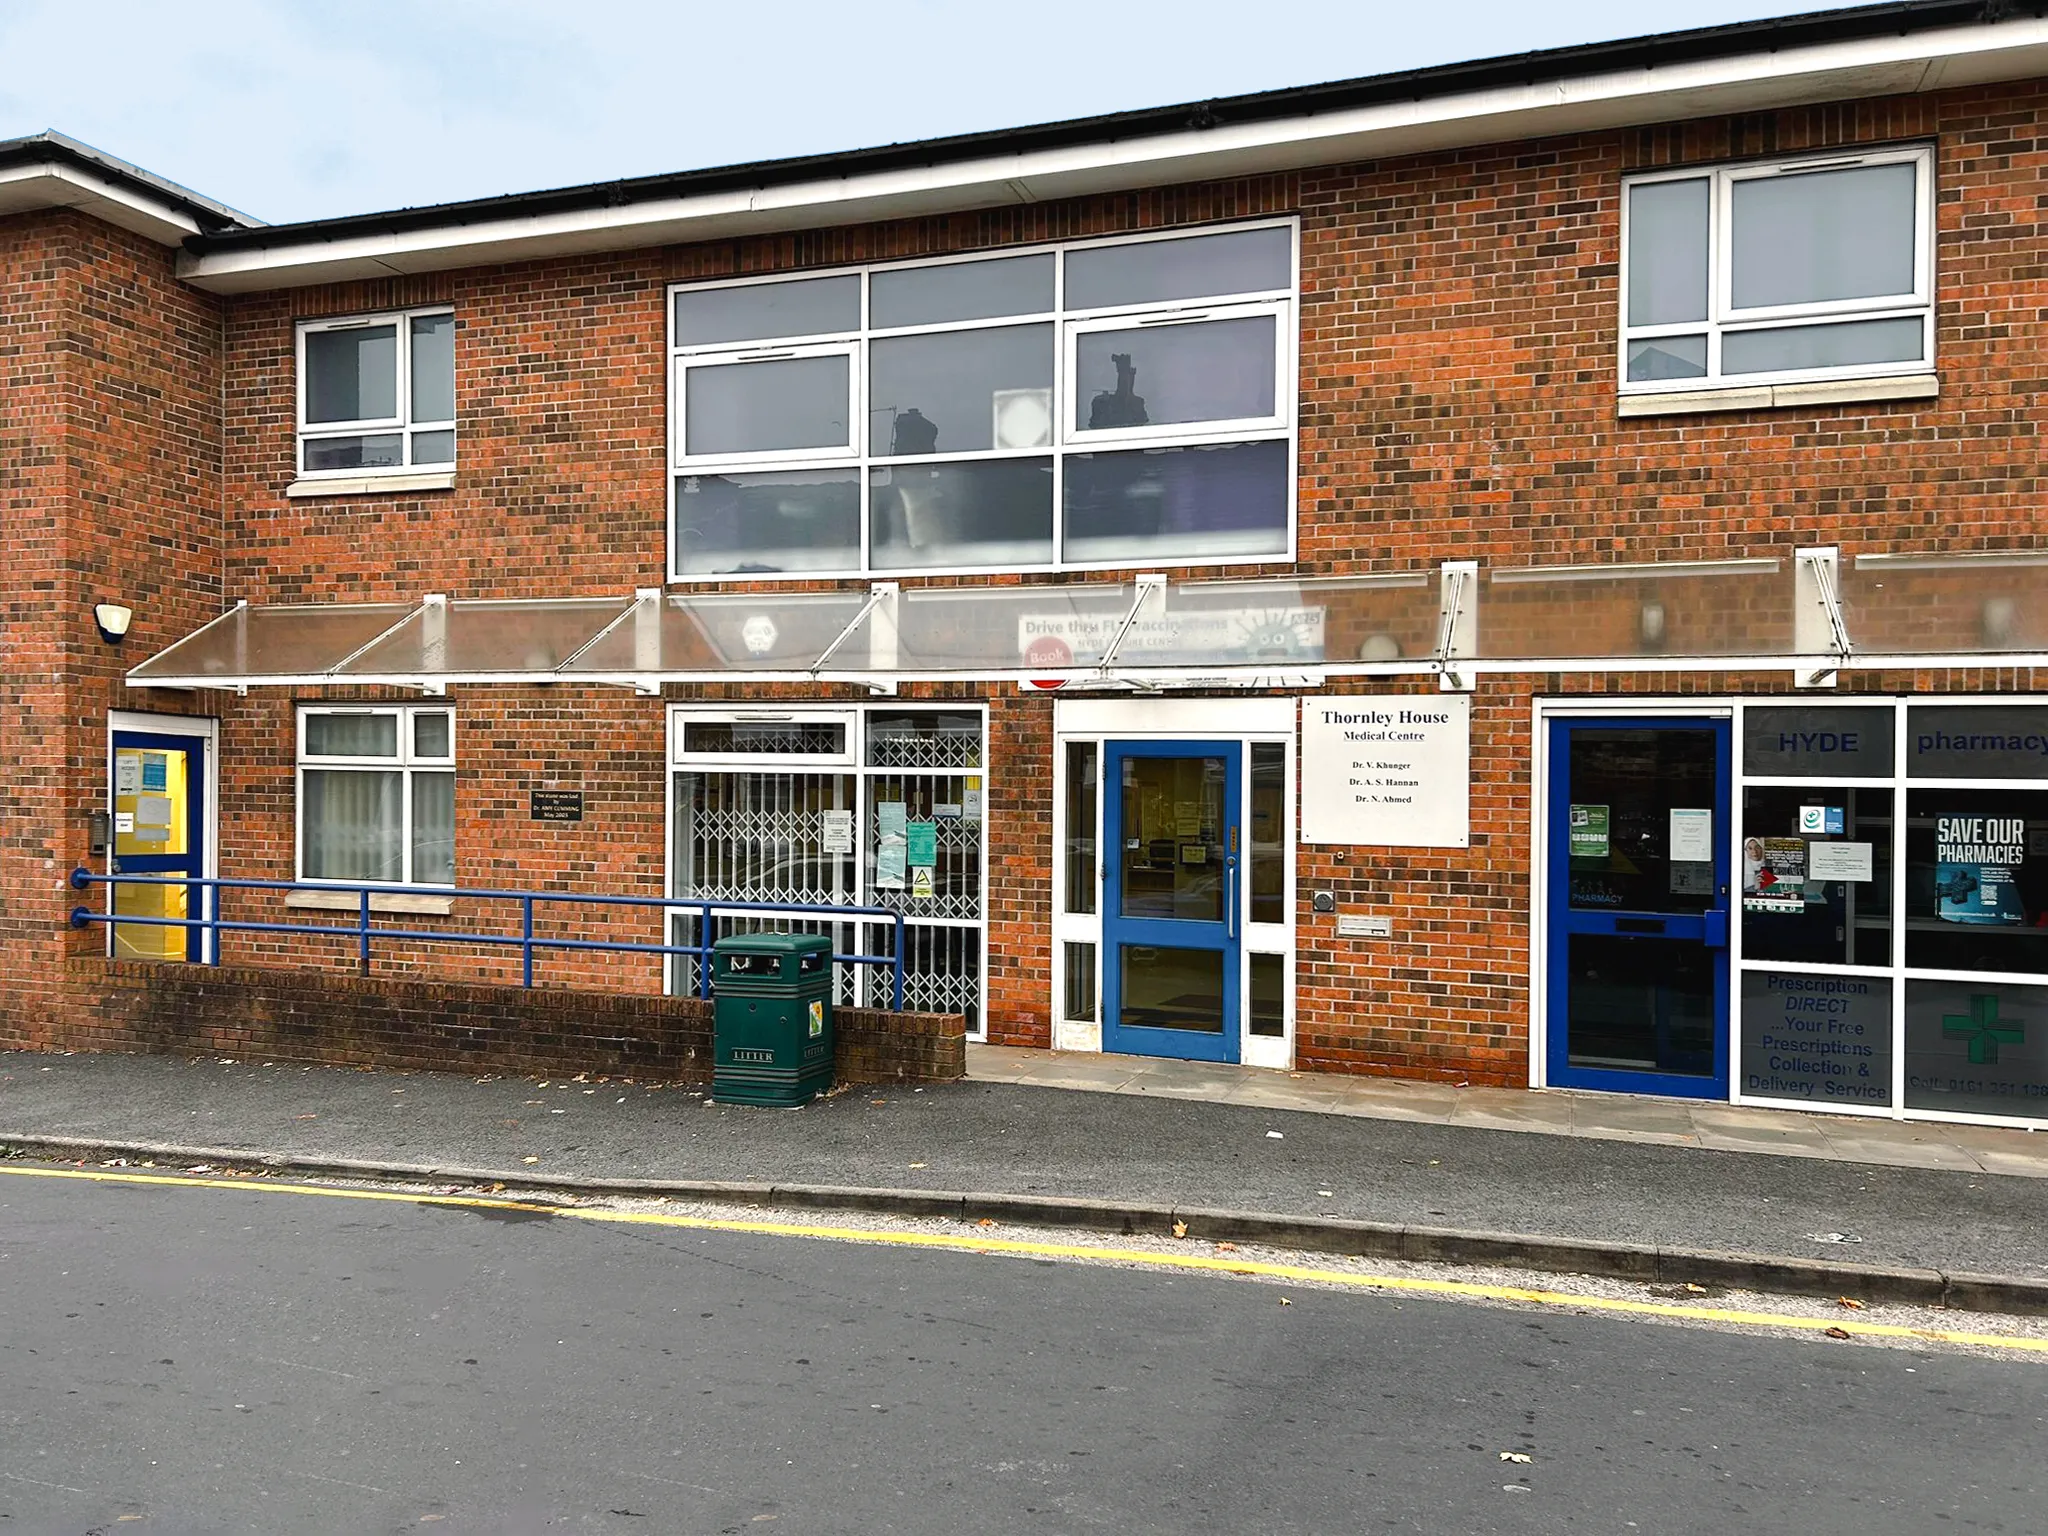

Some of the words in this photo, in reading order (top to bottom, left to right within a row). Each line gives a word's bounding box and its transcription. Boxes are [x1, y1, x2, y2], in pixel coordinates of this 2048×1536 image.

[1025, 620, 1064, 634] Drive
[1030, 648, 1065, 664] Book
[1321, 710, 1394, 727] Thornley
[1399, 710, 1450, 724] House
[1344, 731, 1385, 741] Medical
[1388, 731, 1425, 741] Centre
[1779, 732, 1859, 752] HYDE
[1918, 731, 2048, 755] pharmacy
[1352, 761, 1365, 769] Dr.
[1366, 761, 1375, 769] V.
[1349, 778, 1363, 786] Dr.
[1364, 778, 1374, 786] A.
[1375, 778, 1384, 786] S.
[1386, 778, 1419, 787] Hannan
[1355, 795, 1369, 803] Dr.
[1371, 795, 1381, 803] N.
[1382, 796, 1412, 804] Ahmed
[1938, 818, 1983, 843] SAVE
[1986, 819, 2025, 844] OUR
[1938, 845, 2024, 865] PHARMACIES
[1572, 894, 1624, 904] PHARMACY
[1768, 975, 1868, 996] Prescription
[1785, 996, 1851, 1014] DIRECT
[1828, 1019, 1865, 1036] Free
[1763, 1035, 1873, 1057] Prescriptions
[734, 1051, 773, 1061] LITTER
[1769, 1056, 1853, 1076] Collection
[1858, 1062, 1870, 1077] &
[1749, 1075, 1814, 1097] Delivery
[1824, 1080, 1887, 1099] Service
